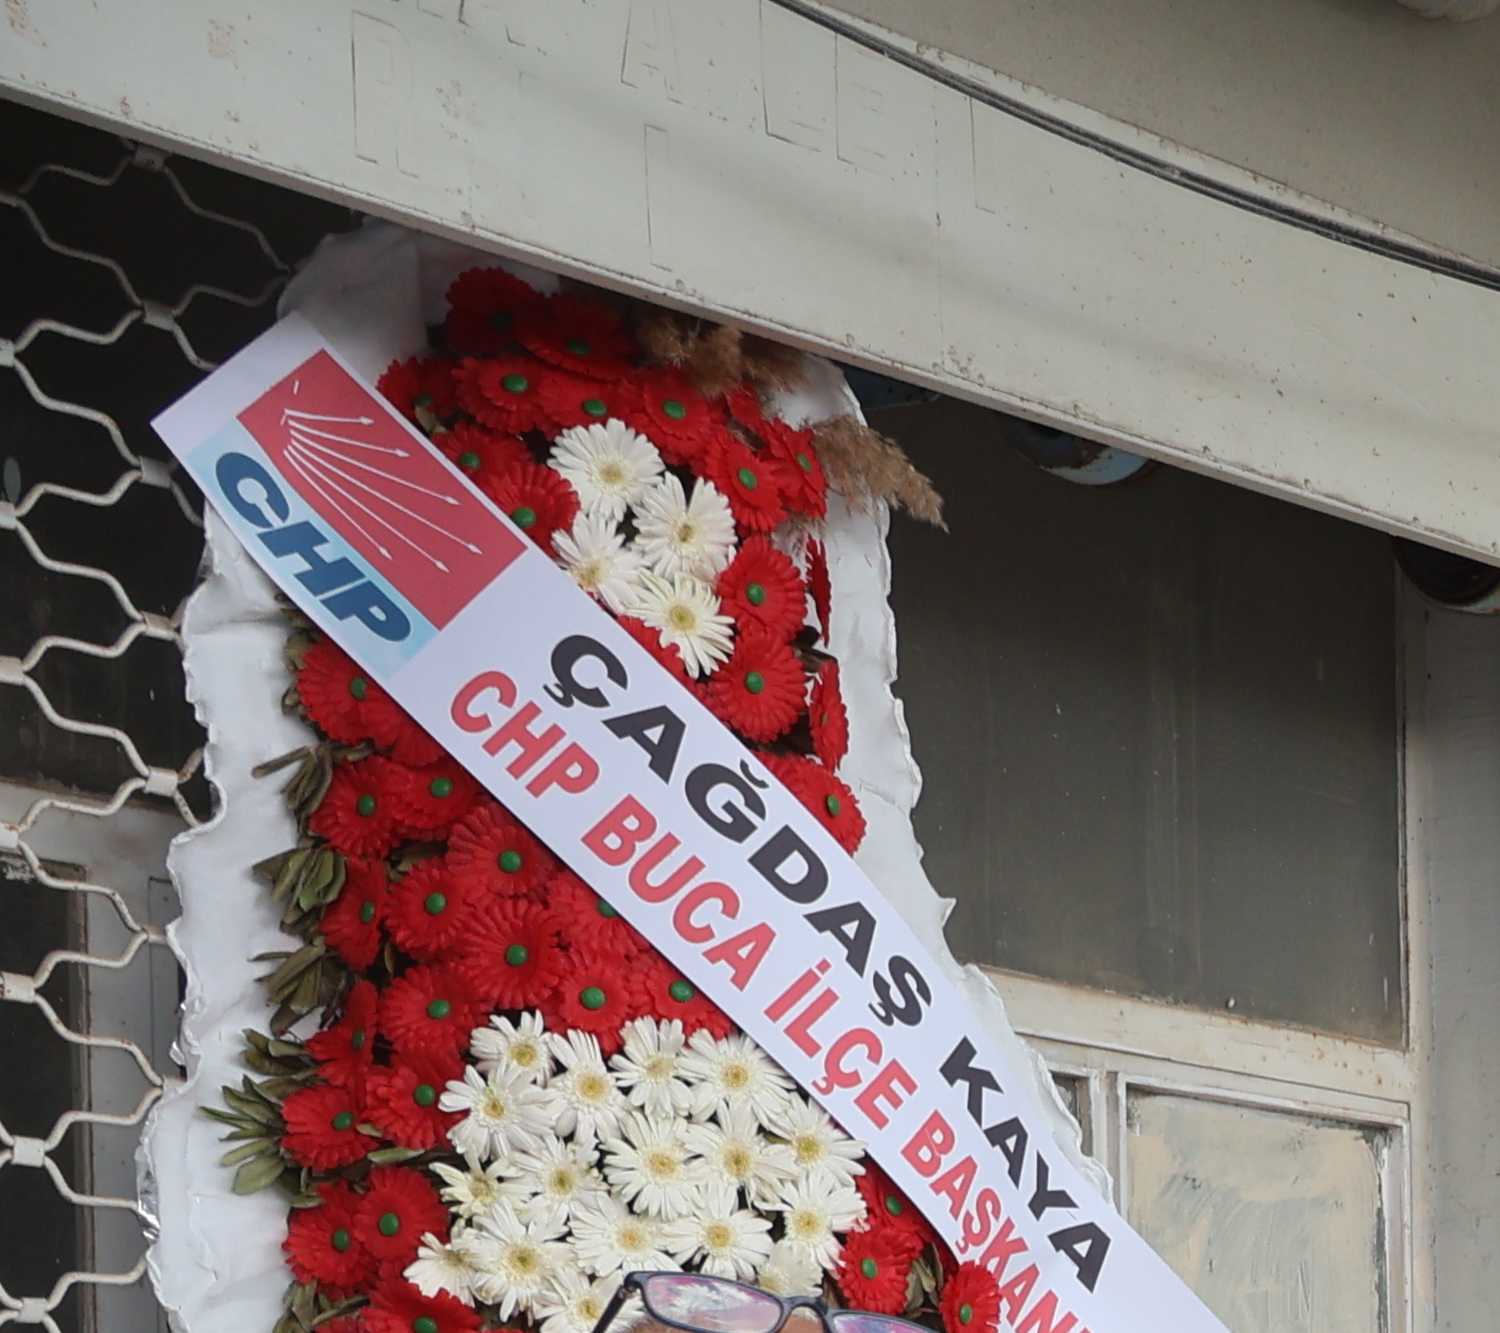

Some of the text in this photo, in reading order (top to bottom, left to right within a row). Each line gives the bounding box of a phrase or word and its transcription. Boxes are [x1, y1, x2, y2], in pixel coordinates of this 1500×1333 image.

[216, 452, 411, 642] CHP
[450, 670, 601, 799] CHP
[580, 794, 777, 992] BUCA
[763, 958, 919, 1131] İLÇE
[543, 634, 1112, 1294] ÇAĞDAŞ KAYA
